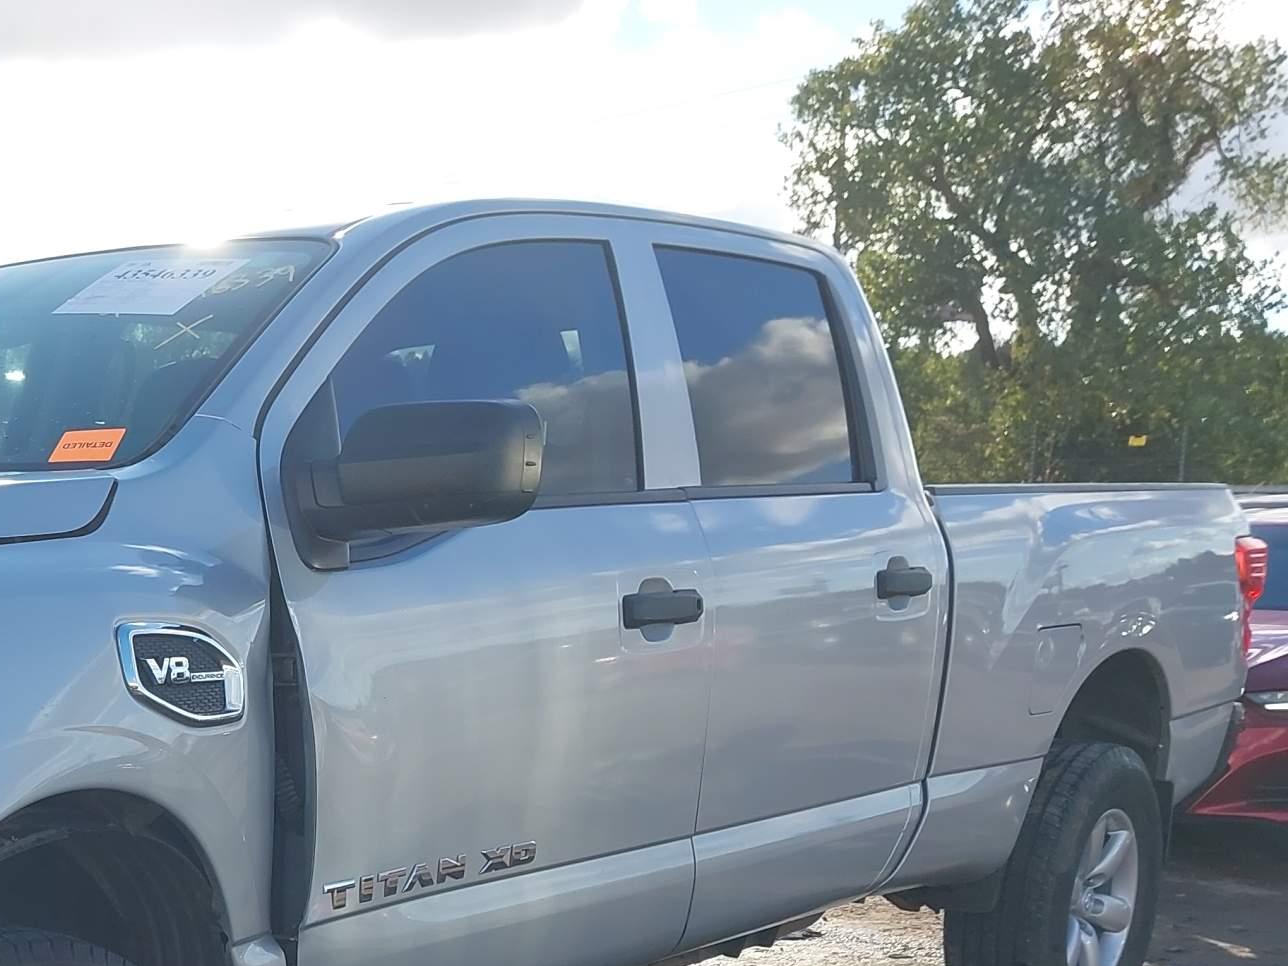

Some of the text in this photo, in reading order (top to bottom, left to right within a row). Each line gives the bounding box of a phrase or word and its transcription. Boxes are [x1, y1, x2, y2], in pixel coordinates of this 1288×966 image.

[62, 441, 114, 449] DETAILED
[141, 656, 191, 685] V8
[322, 840, 537, 910] TITAN XD
